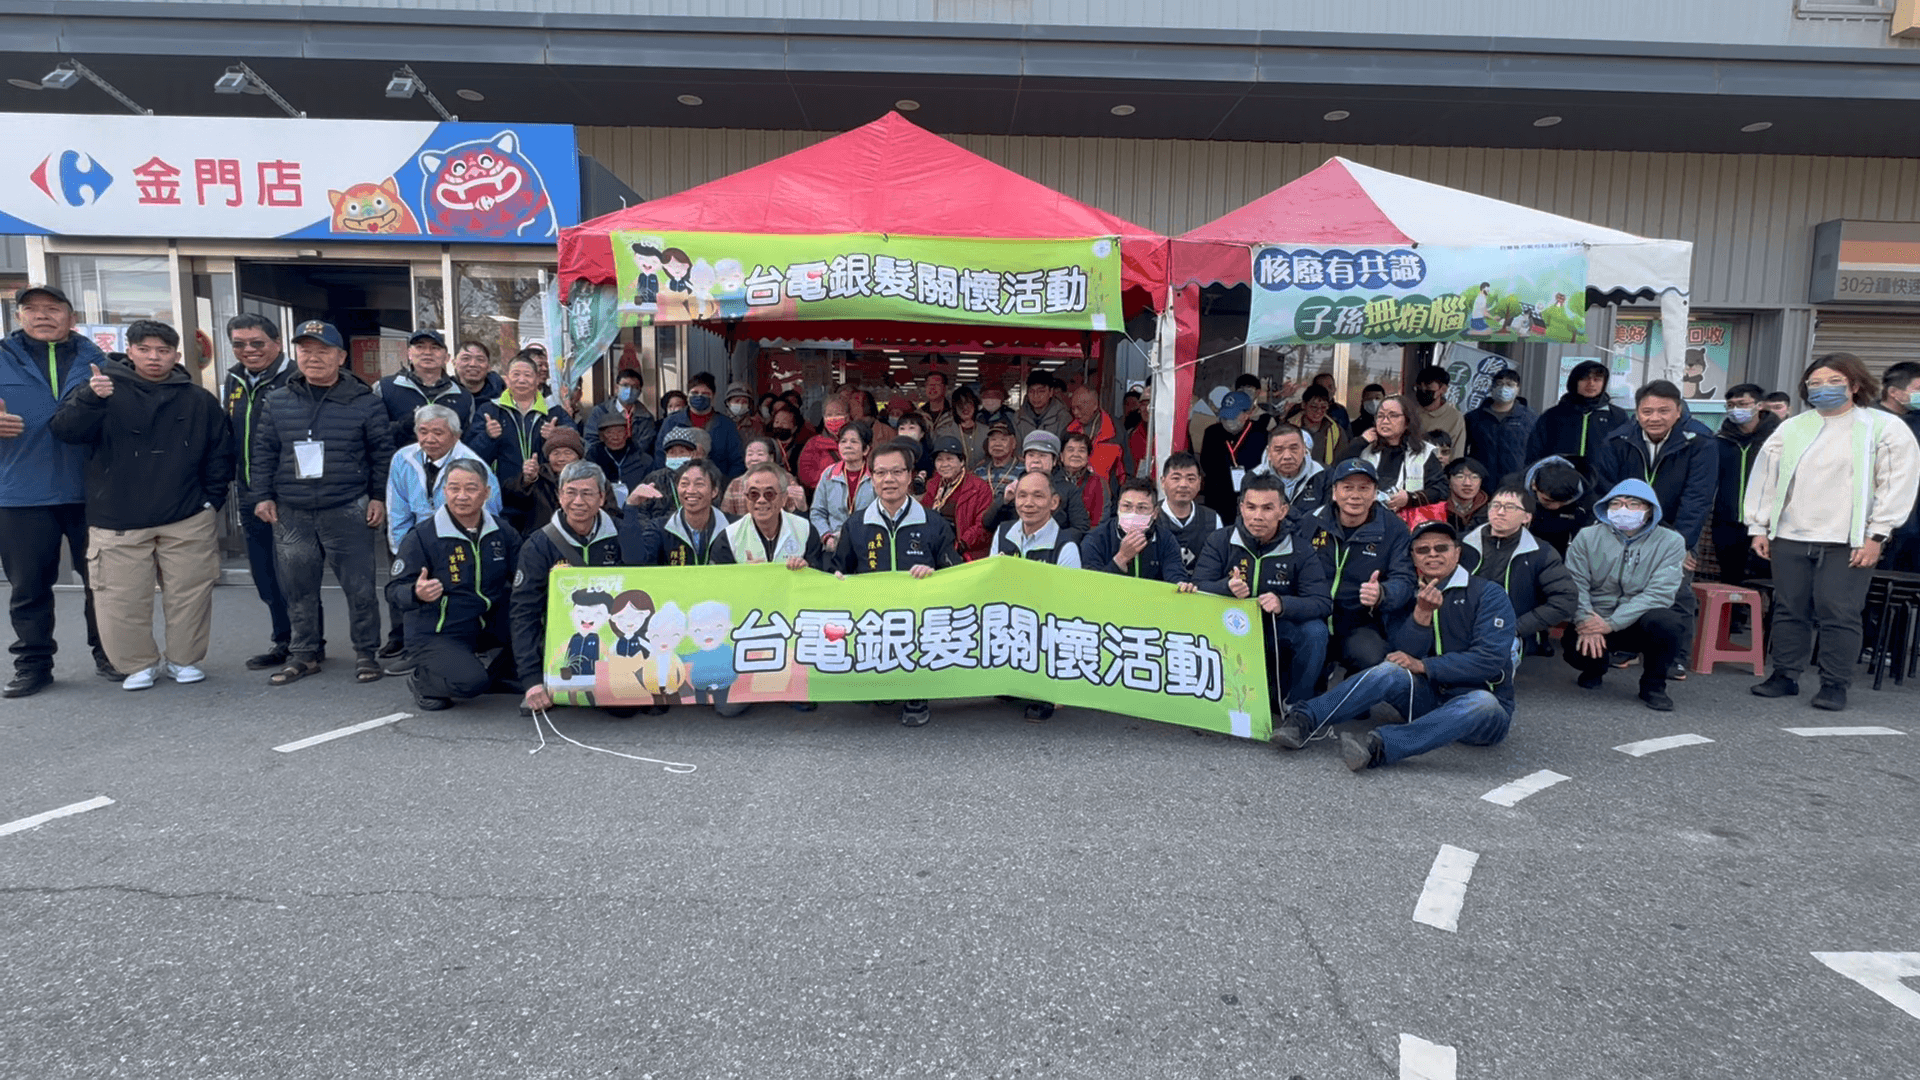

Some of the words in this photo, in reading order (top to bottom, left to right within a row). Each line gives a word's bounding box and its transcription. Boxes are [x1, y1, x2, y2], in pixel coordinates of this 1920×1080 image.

[132, 156, 303, 207] 金門店
[745, 253, 1088, 316] 台電銀髮關懷活動
[1259, 254, 1422, 285] 核廢有共識
[1301, 297, 1466, 336] 子孫無煩惱
[731, 602, 1226, 702] 台電銀髮關懷活動
